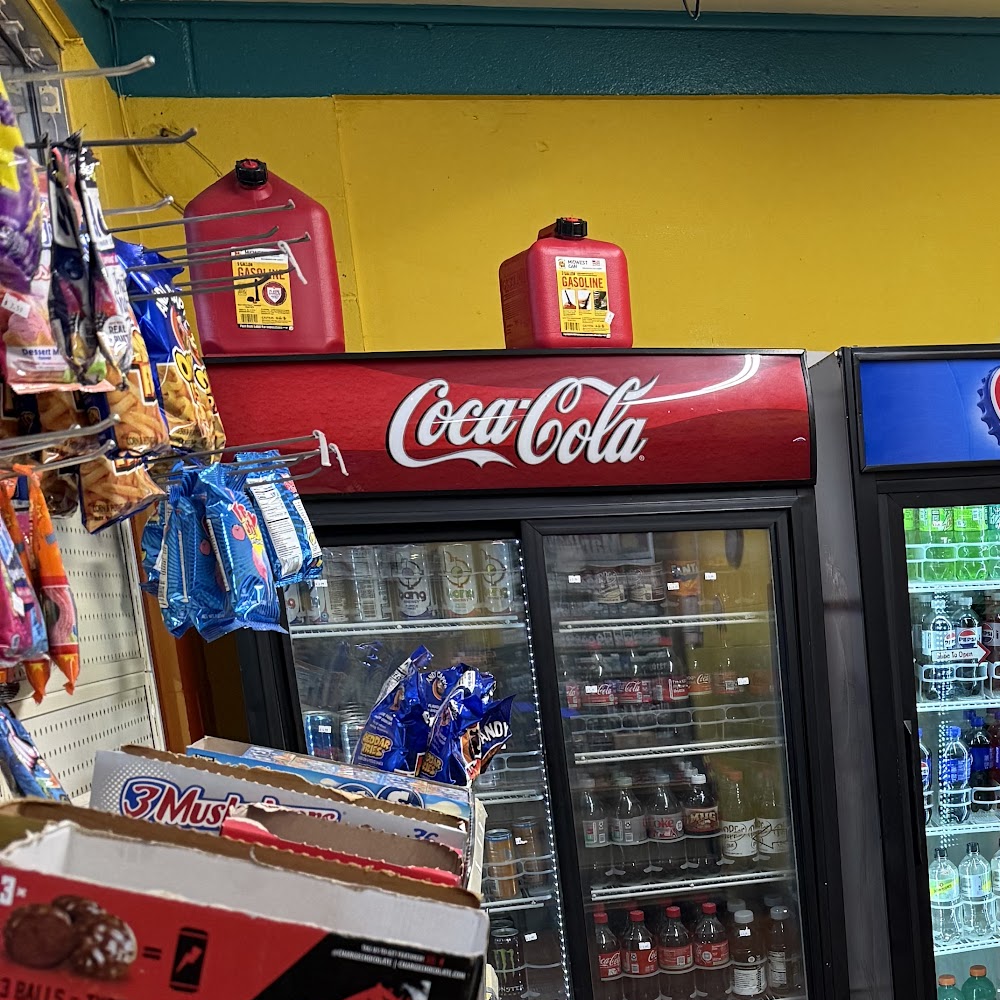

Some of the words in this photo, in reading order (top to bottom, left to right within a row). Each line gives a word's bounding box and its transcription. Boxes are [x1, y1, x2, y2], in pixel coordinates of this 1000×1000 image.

[562, 277, 604, 289] GASOLINE
[22, 348, 52, 356] Dessert
[385, 374, 660, 469] Coca-Cola
[124, 784, 156, 819] 3
[690, 811, 717, 824] MUG
[0, 978, 10, 998] 3
